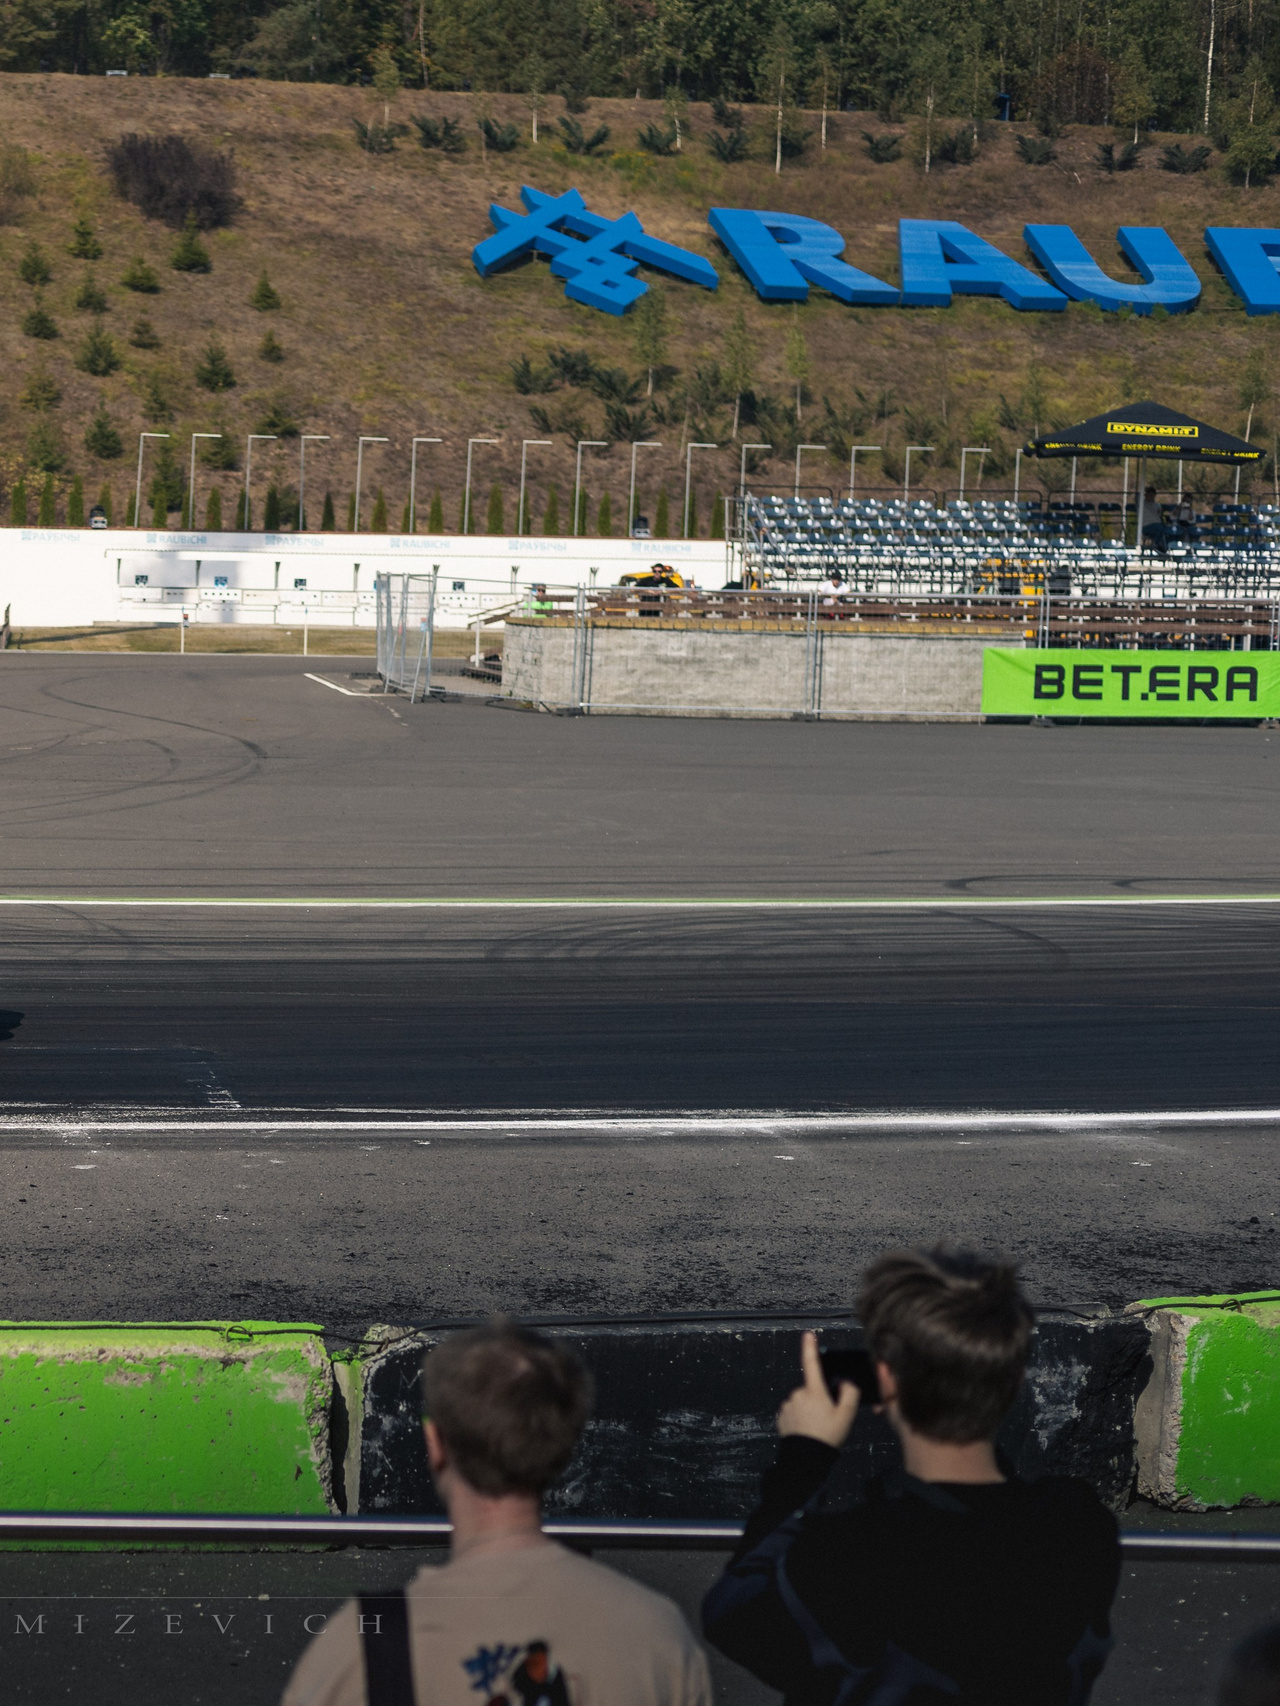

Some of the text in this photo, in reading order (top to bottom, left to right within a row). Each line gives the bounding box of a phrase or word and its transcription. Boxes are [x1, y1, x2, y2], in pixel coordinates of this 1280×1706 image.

[1122, 443, 1181, 453] ENERGY DRINK
[159, 534, 207, 545] RAUBICHI
[402, 538, 450, 549] RAUBICHI
